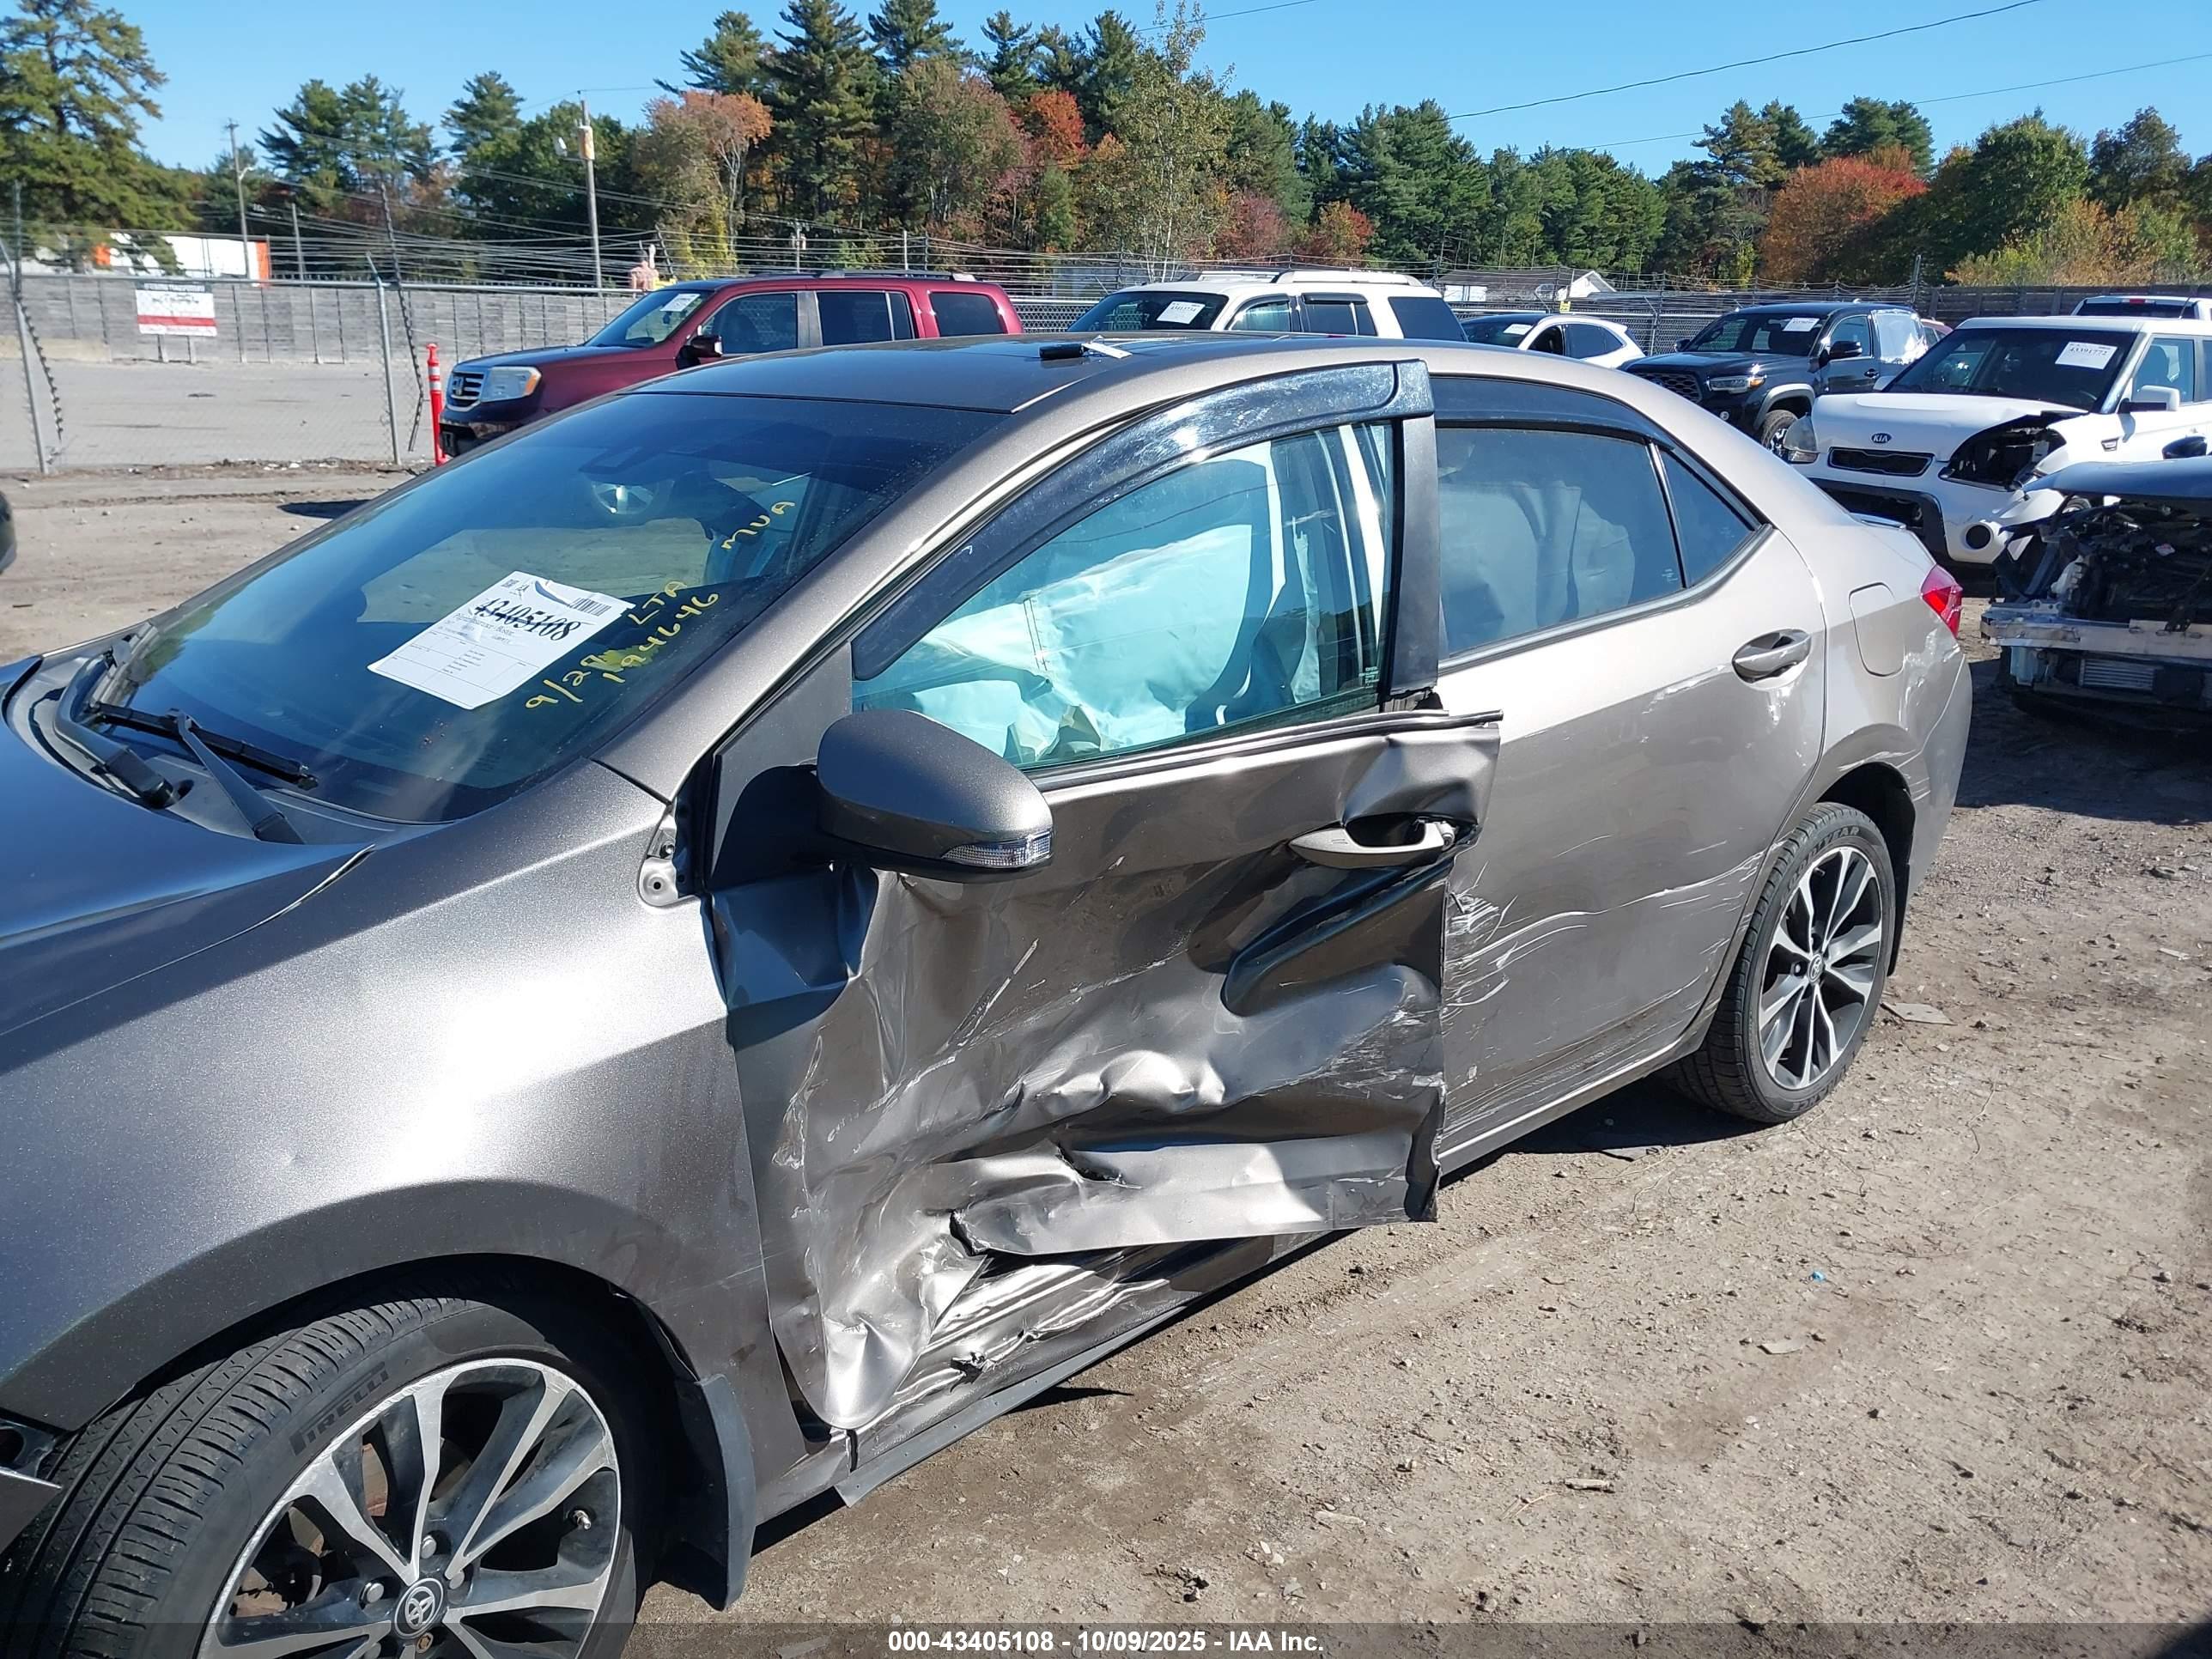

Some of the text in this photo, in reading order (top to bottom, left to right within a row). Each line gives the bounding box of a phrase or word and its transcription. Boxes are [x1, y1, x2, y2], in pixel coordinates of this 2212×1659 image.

[1873, 434, 1889, 442] KIA
[473, 597, 582, 641] 43405108
[628, 580, 687, 625] LTA
[602, 592, 719, 683] 194646
[289, 1361, 389, 1456] PIRELLI
